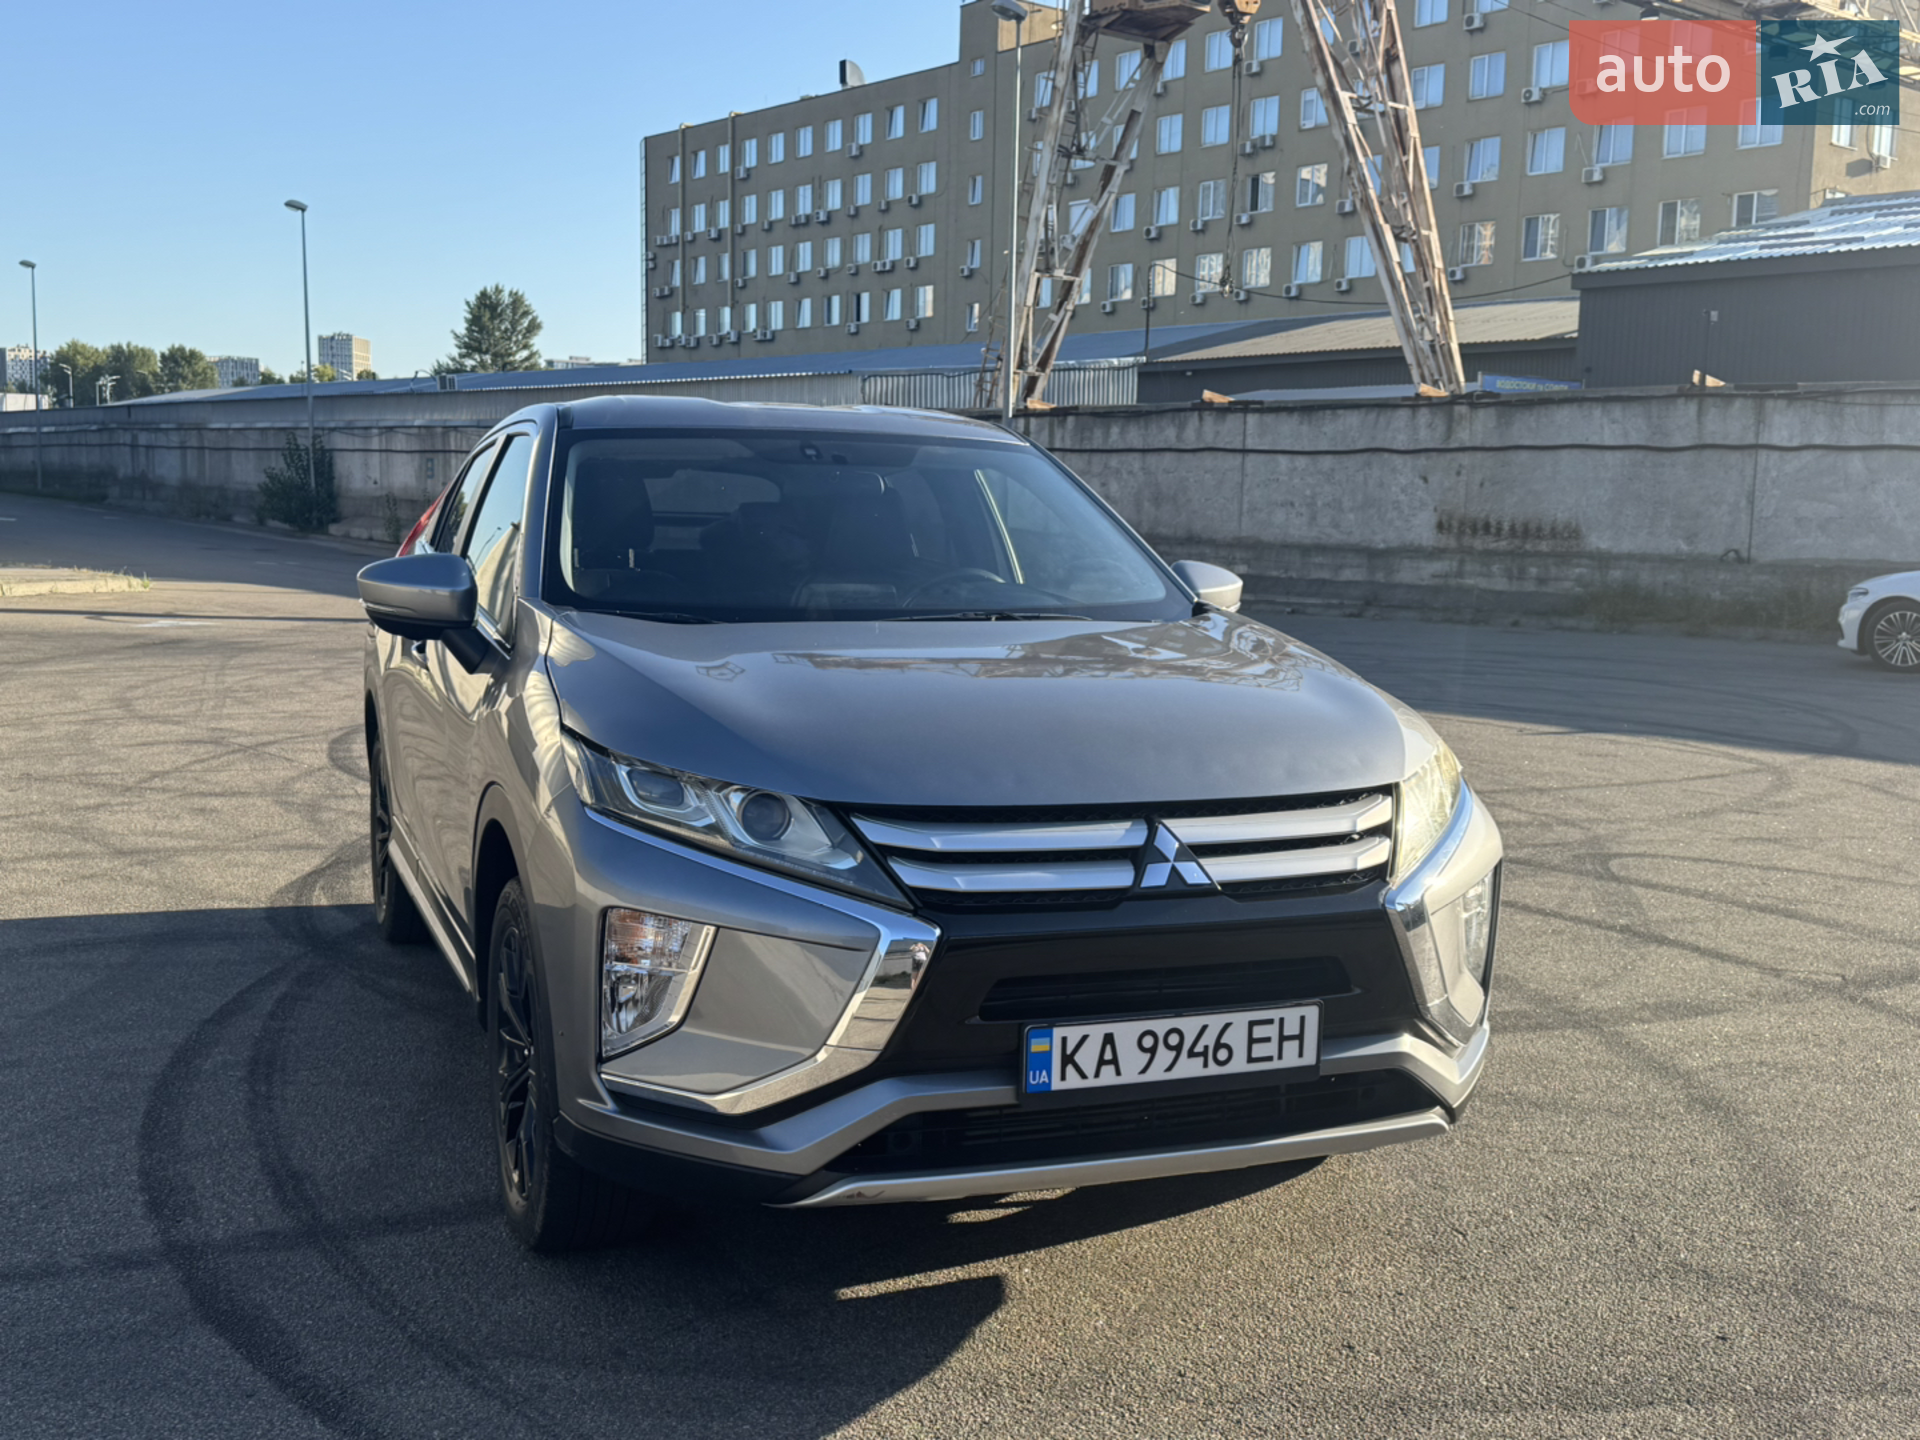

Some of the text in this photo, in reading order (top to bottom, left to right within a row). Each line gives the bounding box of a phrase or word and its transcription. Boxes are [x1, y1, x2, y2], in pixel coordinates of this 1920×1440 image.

[1060, 1015, 1306, 1082] KA 9946 EH
[1029, 1069, 1049, 1085] UA
